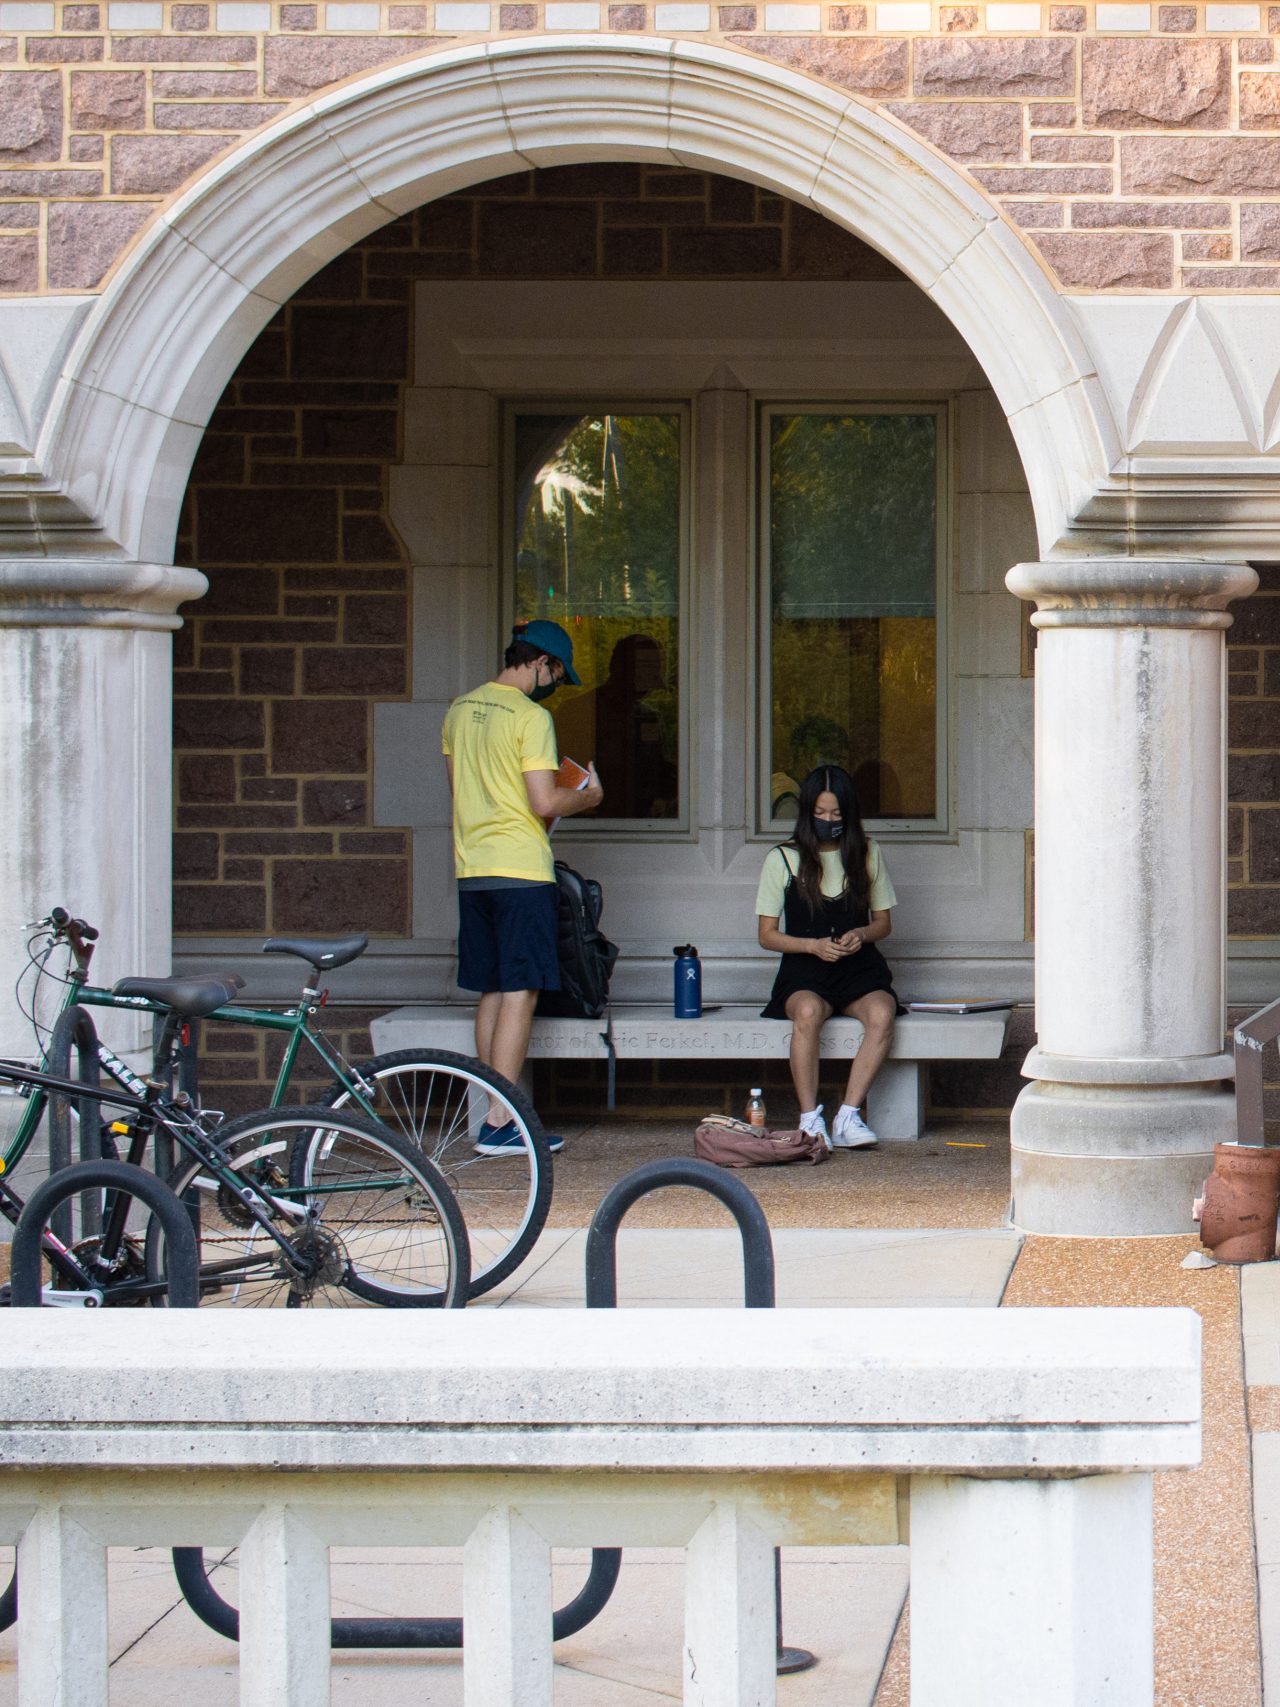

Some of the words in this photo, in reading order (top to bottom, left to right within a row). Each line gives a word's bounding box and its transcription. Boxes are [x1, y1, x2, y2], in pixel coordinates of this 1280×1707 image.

[529, 1036, 565, 1049] nor
[569, 1031, 594, 1049] of
[723, 1032, 775, 1049] M.D.
[98, 1046, 147, 1099] RALE
